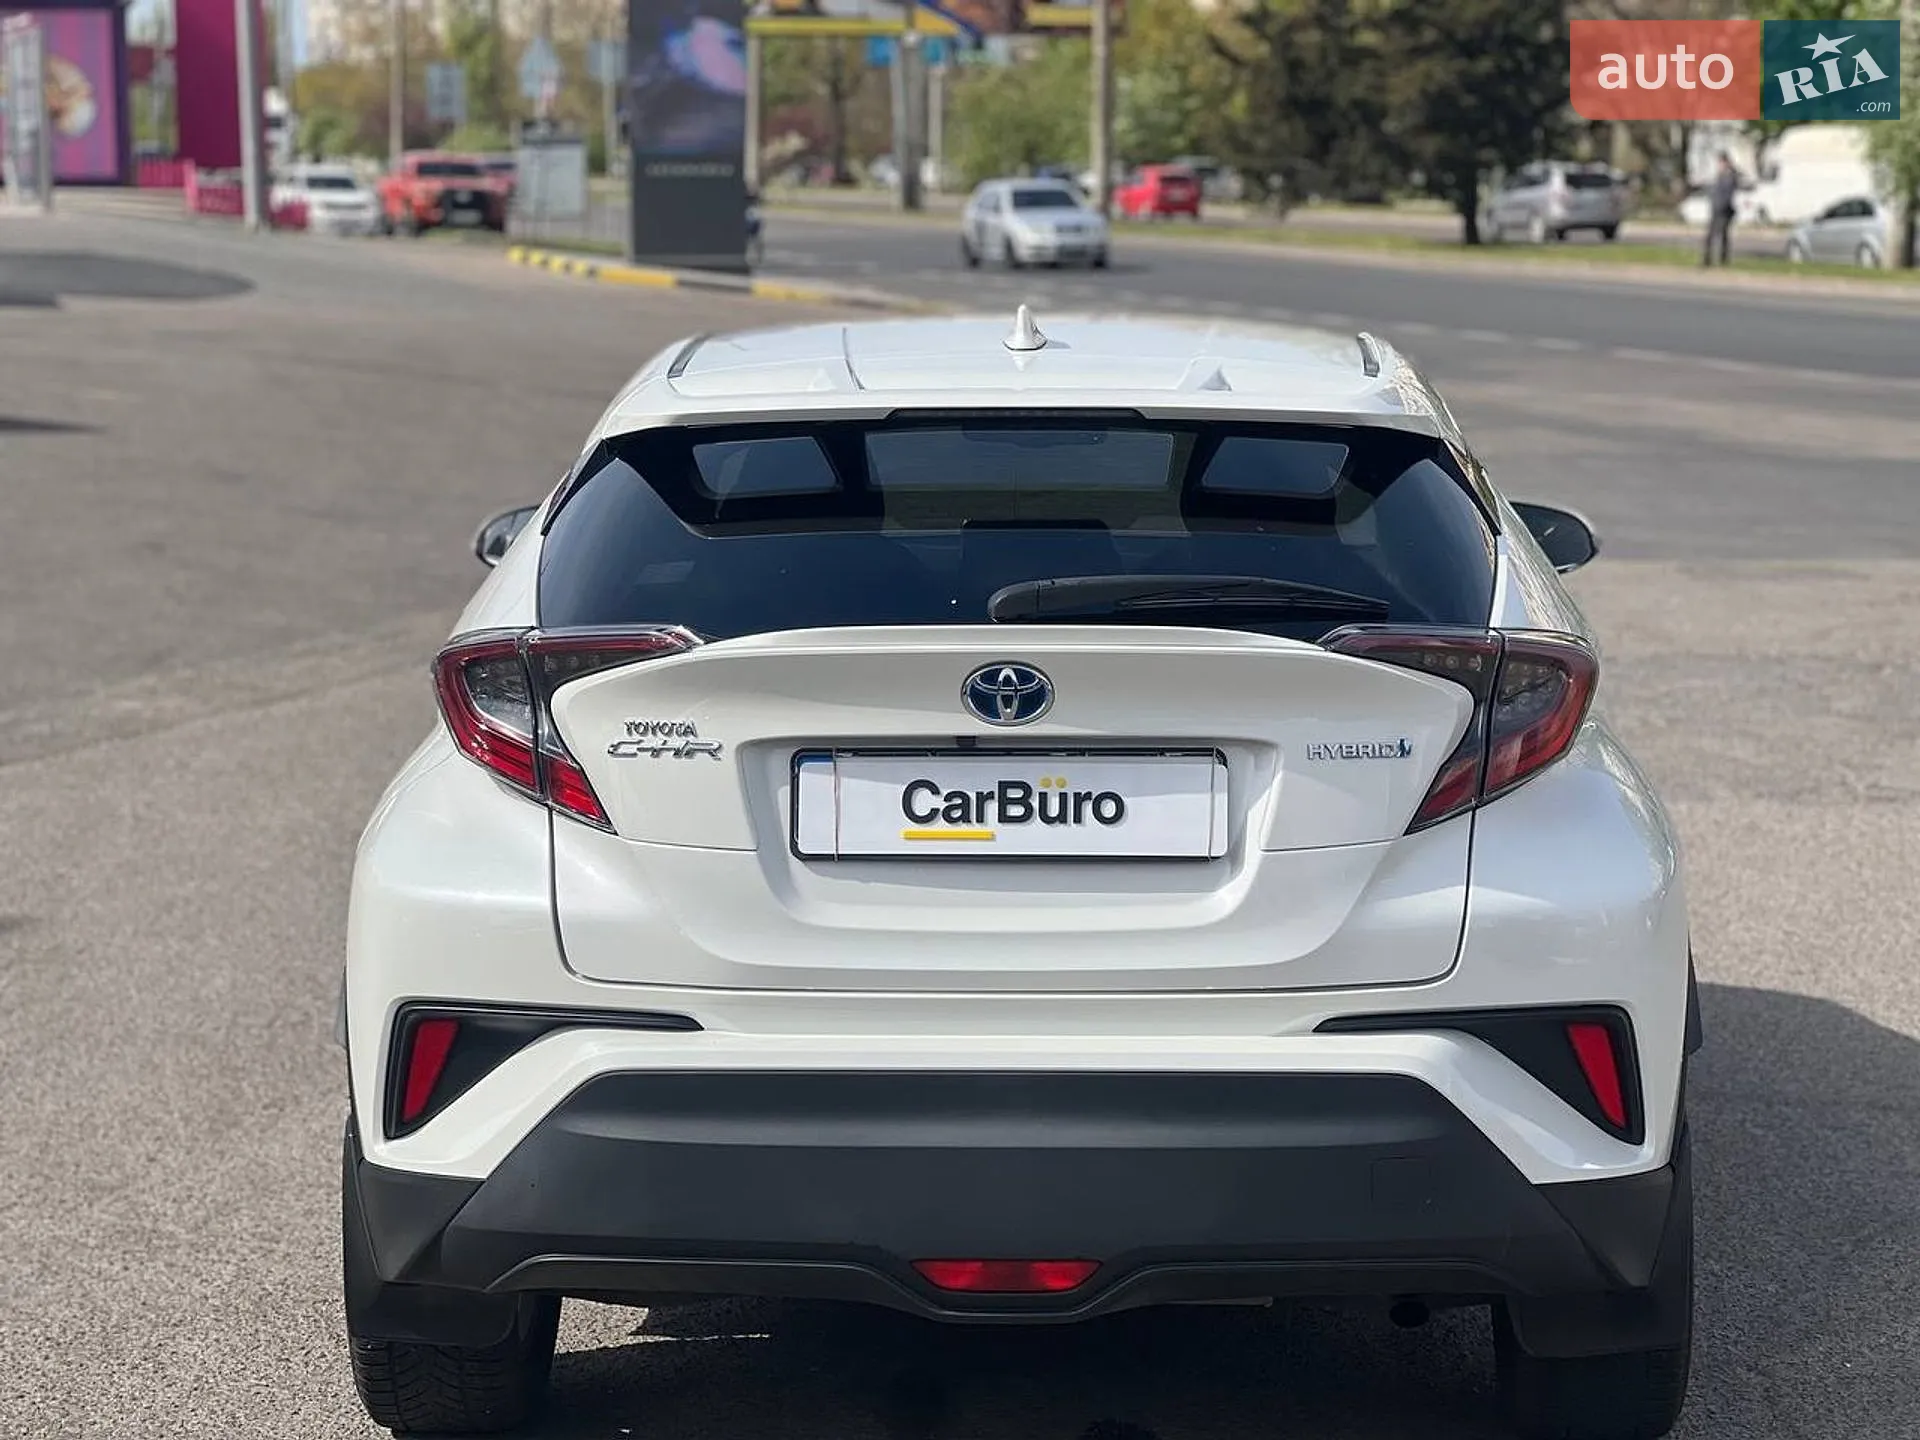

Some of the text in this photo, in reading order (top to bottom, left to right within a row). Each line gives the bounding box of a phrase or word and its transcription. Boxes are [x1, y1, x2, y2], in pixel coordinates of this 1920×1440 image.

[624, 720, 698, 738] TOYOTA
[607, 739, 722, 761] C-HR
[1306, 742, 1397, 760] HYBRID
[901, 776, 1125, 826] CarBüro
